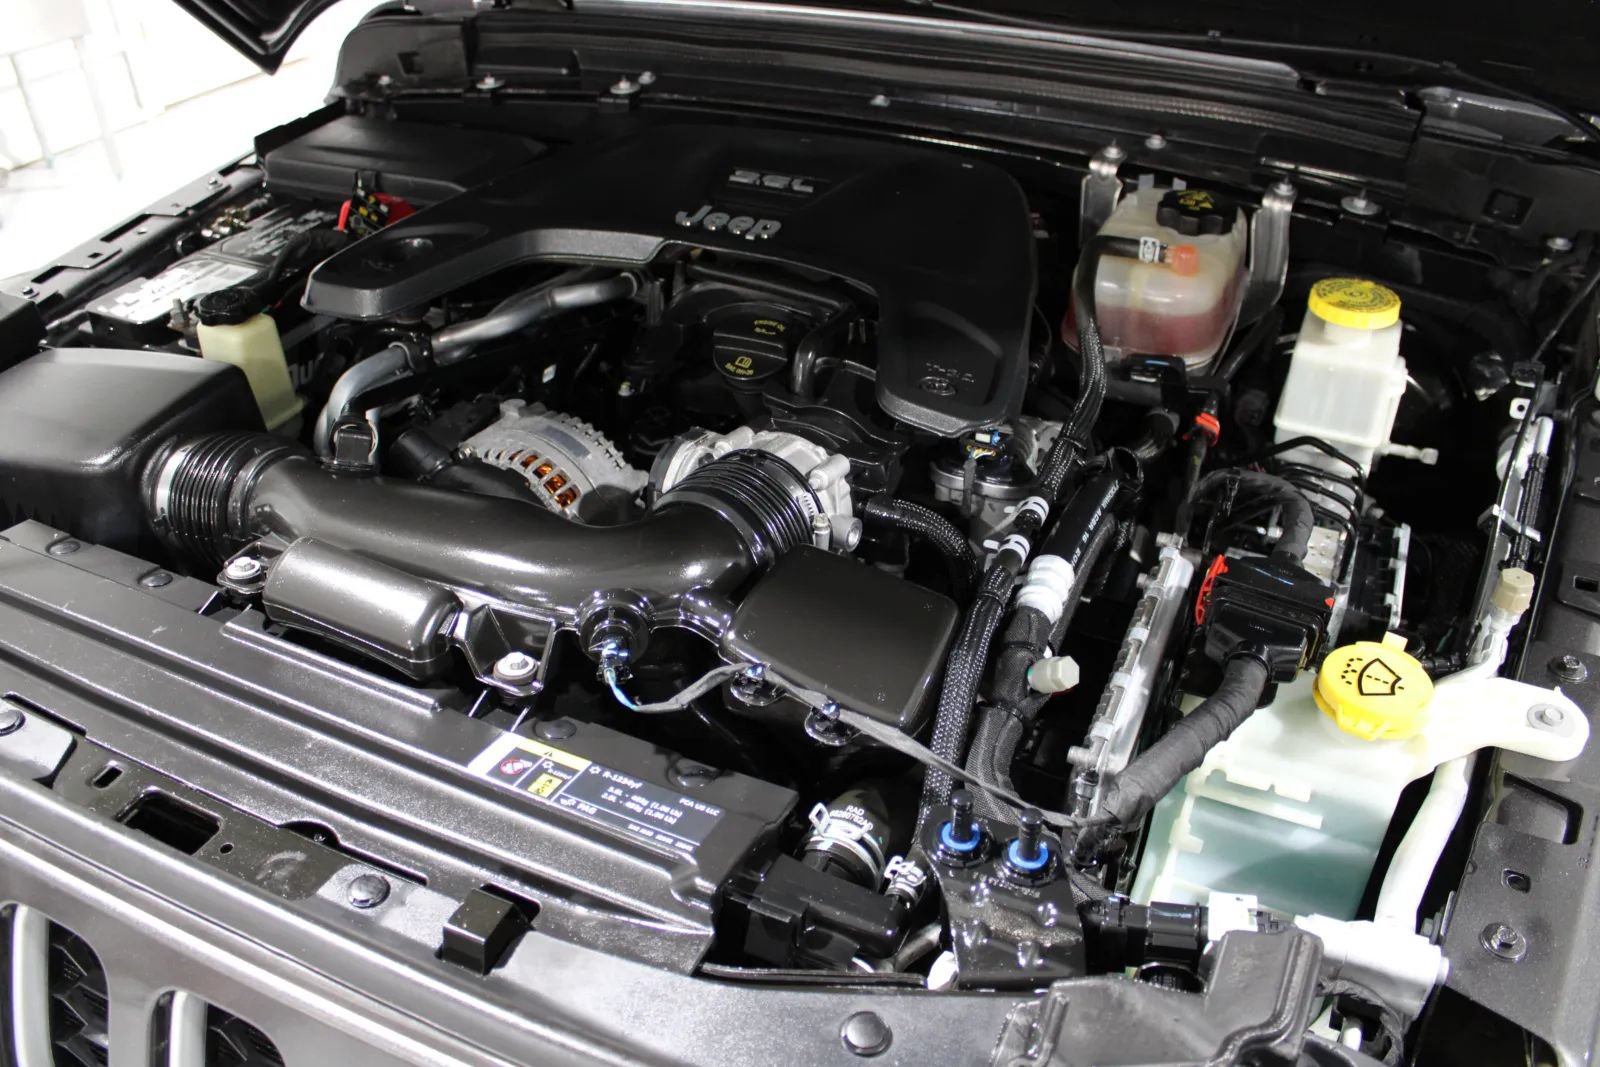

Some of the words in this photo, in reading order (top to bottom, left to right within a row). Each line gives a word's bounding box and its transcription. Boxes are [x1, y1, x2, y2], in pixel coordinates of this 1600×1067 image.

[675, 204, 783, 241] Jeep
[679, 797, 694, 807] FCA
[705, 807, 720, 816] LLC
[845, 804, 865, 817] RAD
